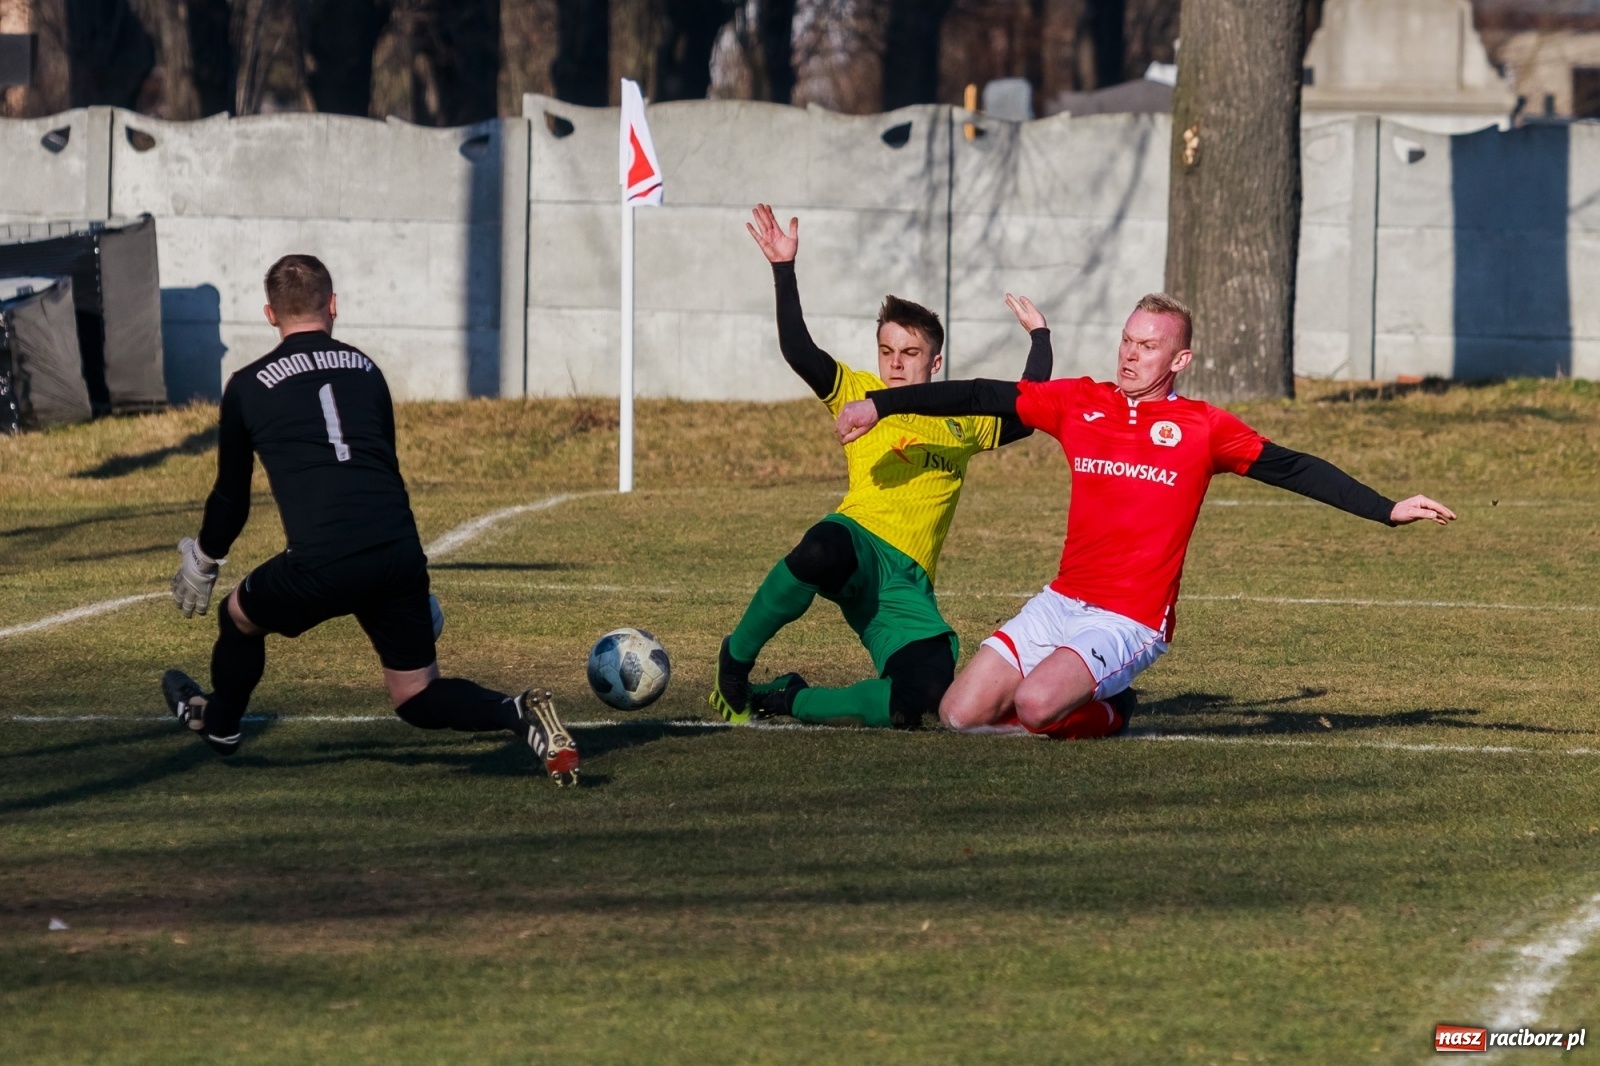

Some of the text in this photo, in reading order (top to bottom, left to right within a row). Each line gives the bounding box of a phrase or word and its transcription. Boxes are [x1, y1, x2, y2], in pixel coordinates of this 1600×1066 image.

[256, 353, 315, 389] ADAM
[318, 383, 351, 462] 1
[1074, 457, 1178, 487] ELEKTROWSKAZ
